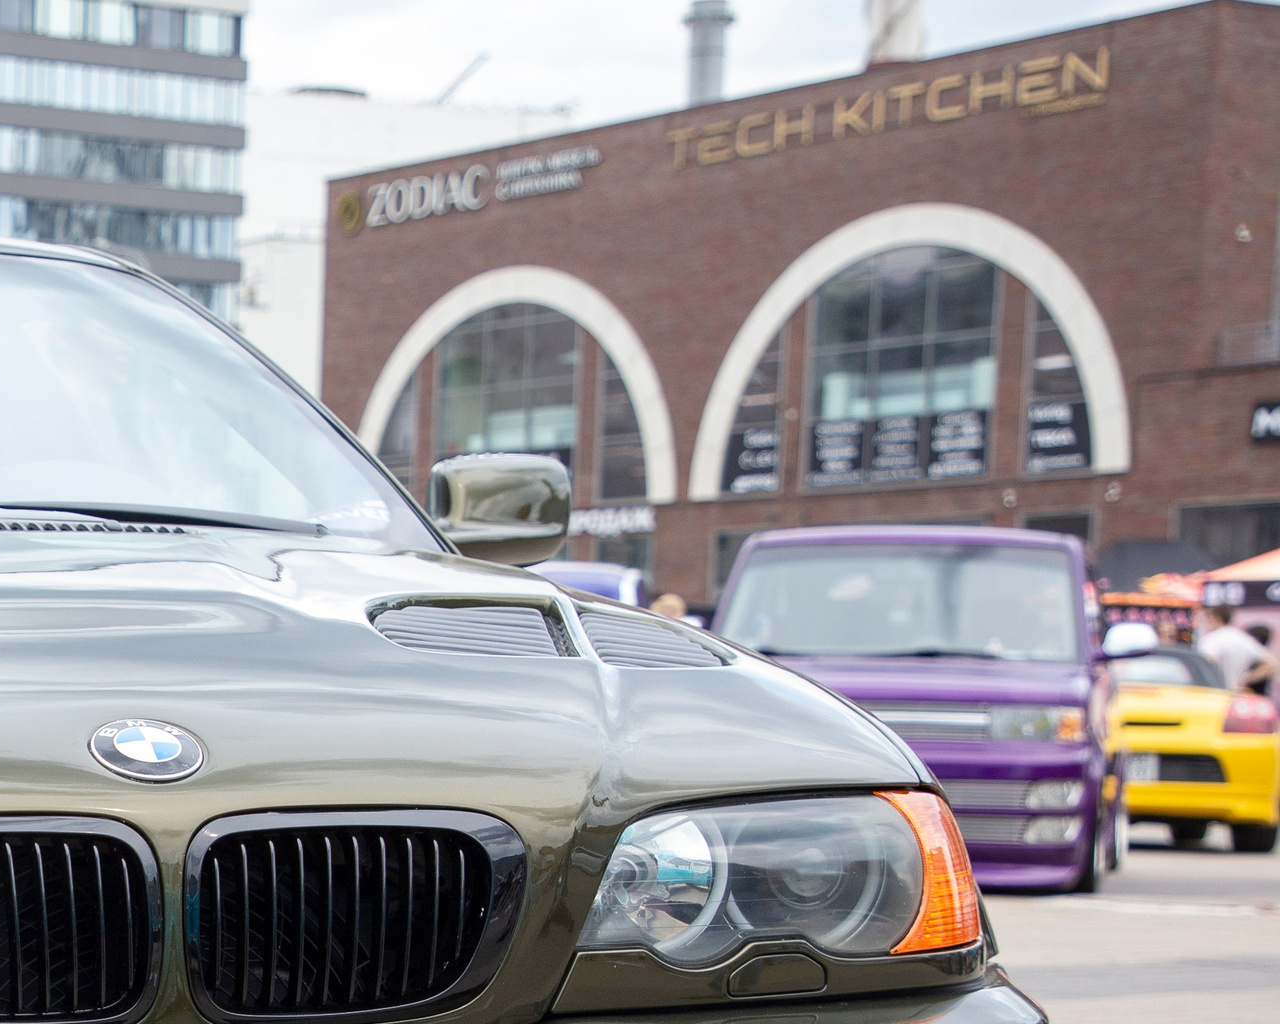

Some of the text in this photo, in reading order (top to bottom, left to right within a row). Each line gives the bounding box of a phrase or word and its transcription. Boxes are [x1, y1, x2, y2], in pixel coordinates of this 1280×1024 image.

[665, 103, 816, 168] TECH
[832, 45, 1111, 139] KITCHEN
[366, 164, 490, 227] ZODIAC
[98, 719, 185, 737] BMW
